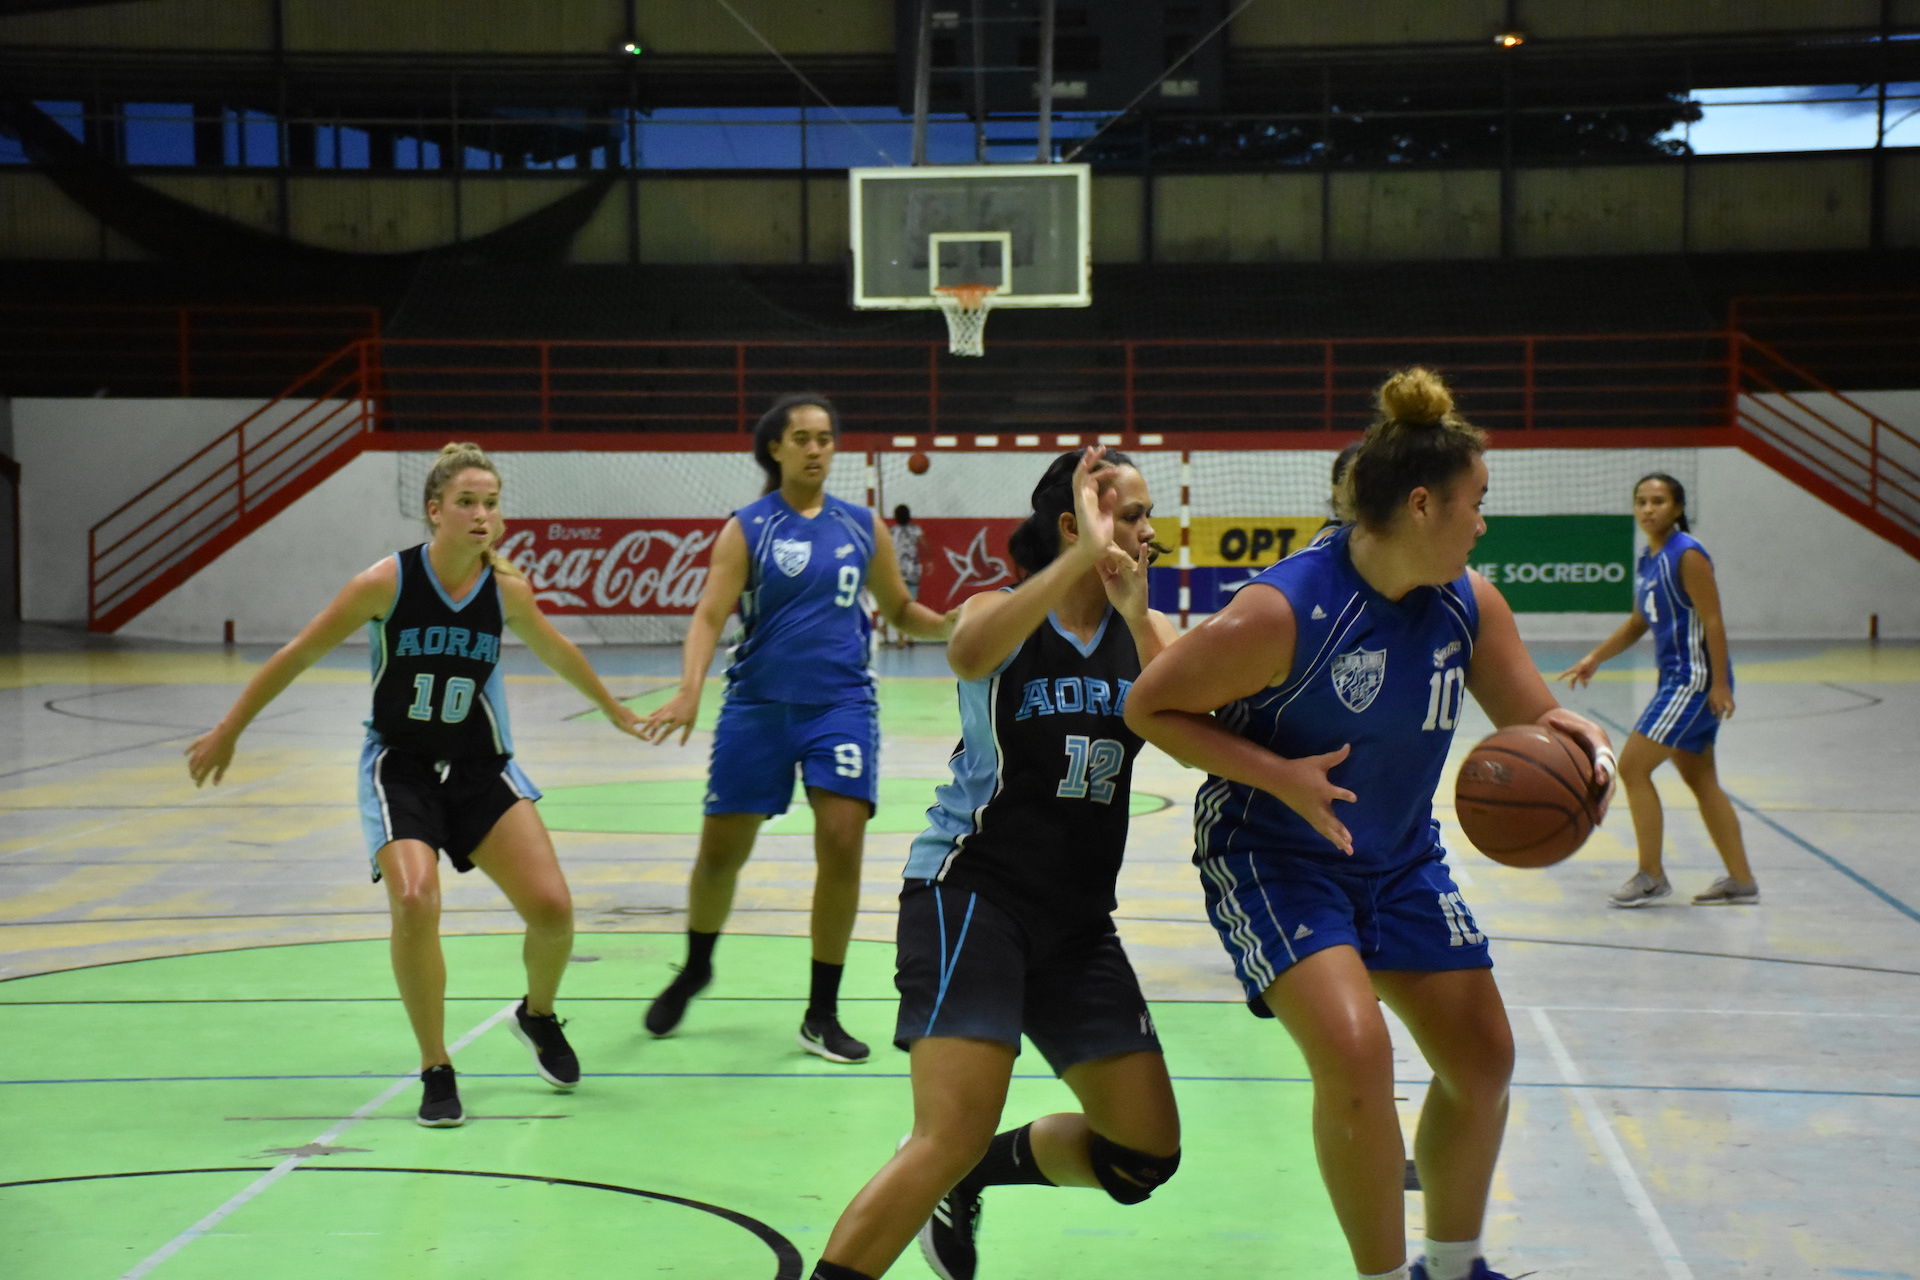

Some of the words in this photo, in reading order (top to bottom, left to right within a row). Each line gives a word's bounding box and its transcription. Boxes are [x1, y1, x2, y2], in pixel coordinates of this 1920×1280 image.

[548, 524, 601, 540] Buvez
[1220, 528, 1296, 561] OPT
[835, 565, 860, 608] 9
[1503, 562, 1625, 583] SOCREDO
[1644, 590, 1658, 623] 4
[407, 673, 476, 724] 10
[1421, 666, 1465, 732] 10
[834, 742, 863, 778] 9
[1056, 734, 1125, 805] 12
[1438, 891, 1485, 947] 10
